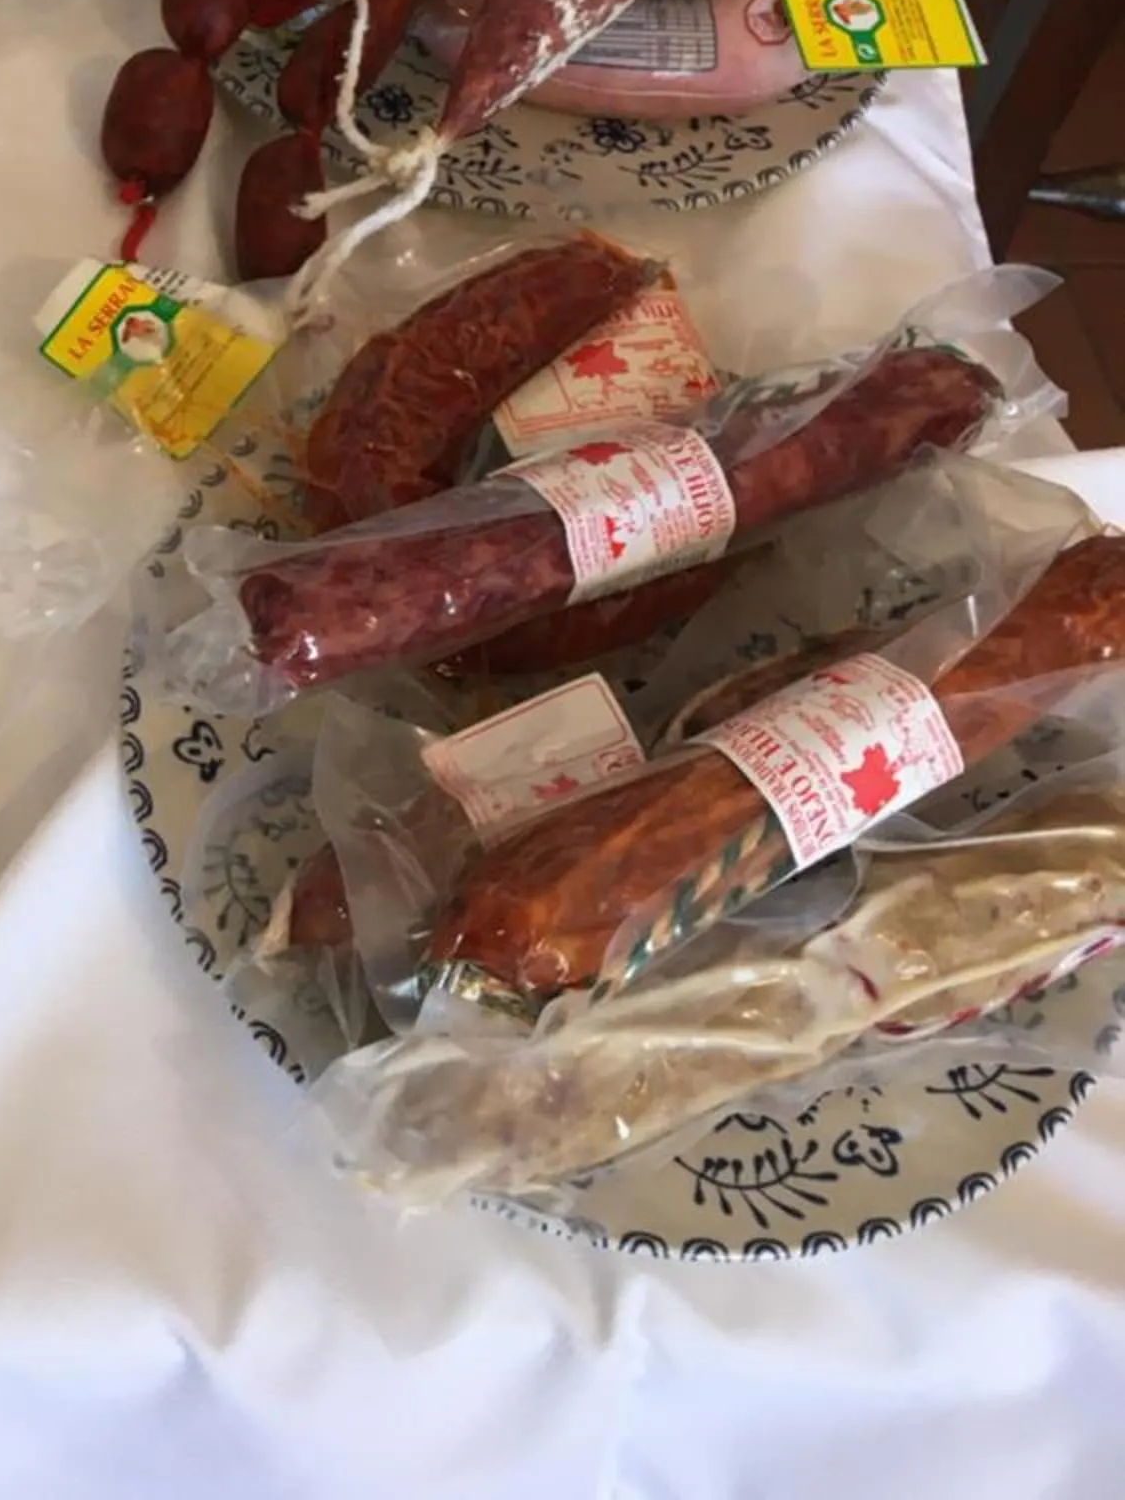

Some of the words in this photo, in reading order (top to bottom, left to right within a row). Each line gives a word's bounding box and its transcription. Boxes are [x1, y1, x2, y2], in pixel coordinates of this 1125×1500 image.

[818, 38, 838, 60] LA
[68, 336, 92, 362] LA
[686, 474, 713, 539] HIJOS
